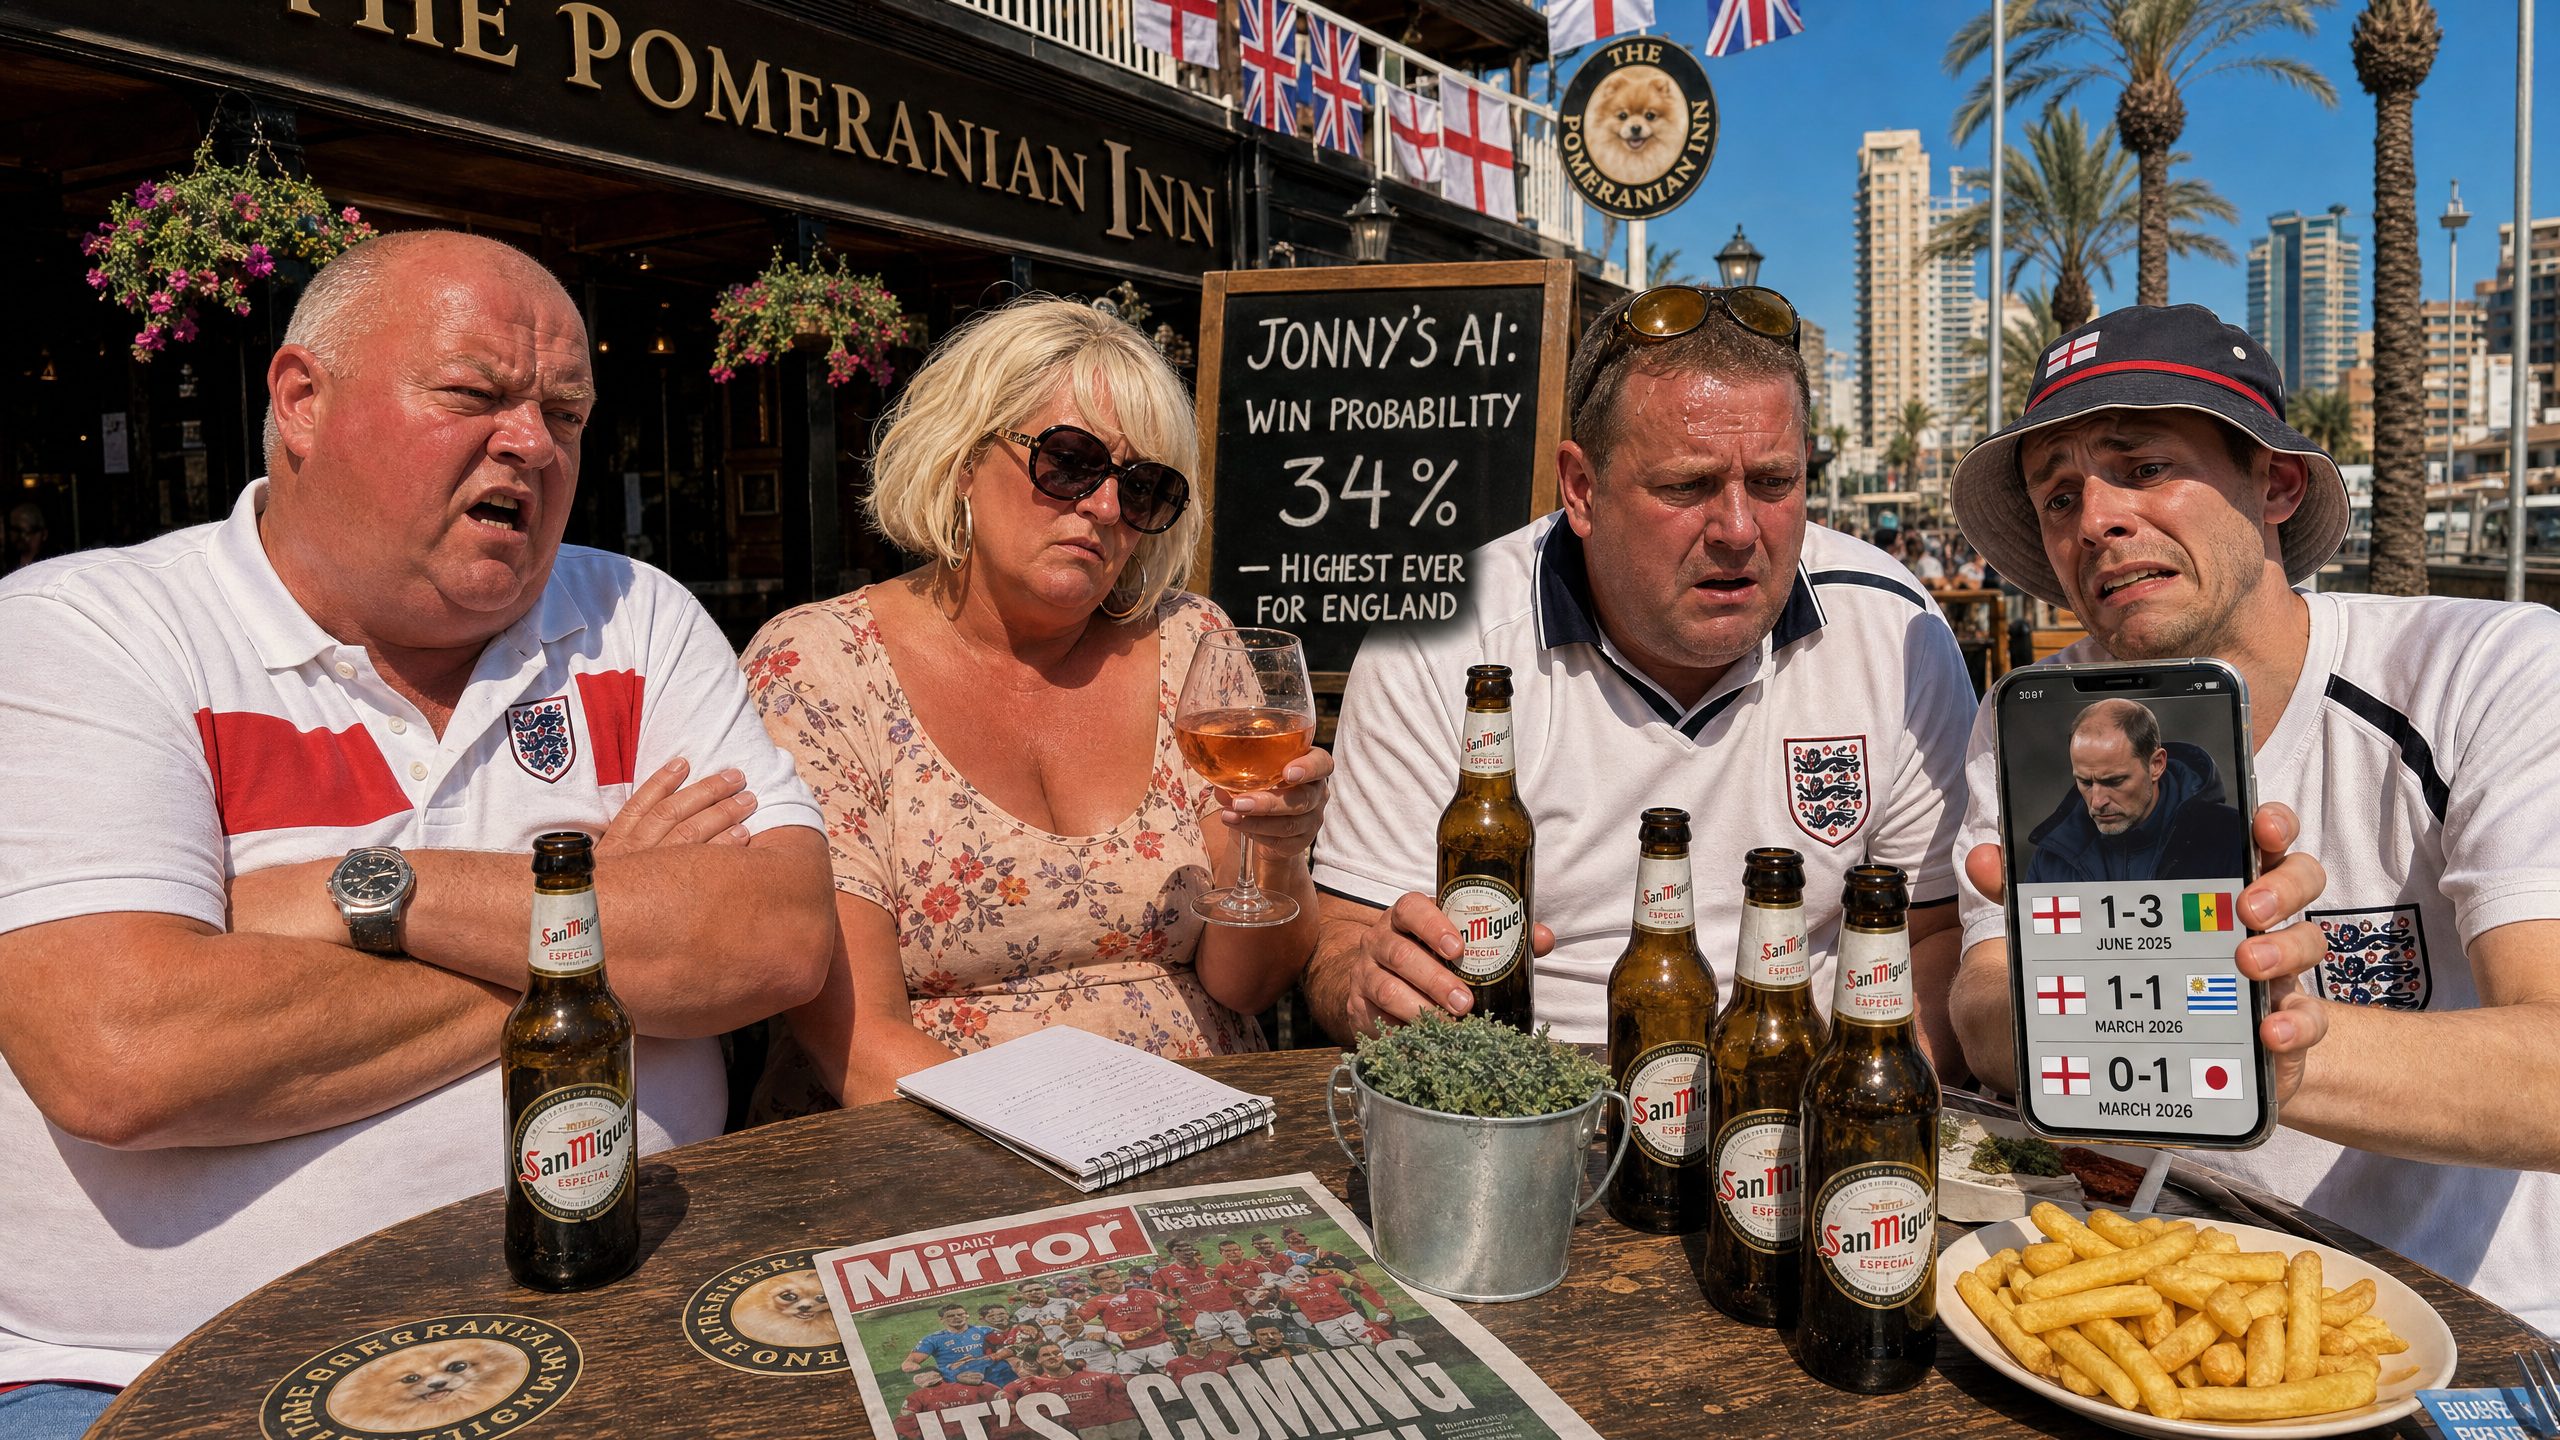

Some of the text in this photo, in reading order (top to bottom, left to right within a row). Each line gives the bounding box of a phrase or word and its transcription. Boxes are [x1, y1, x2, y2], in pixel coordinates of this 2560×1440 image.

[1607, 43, 1663, 67] THE
[556, 2, 1087, 212] POMERANIAN
[1104, 139, 1215, 247] INN
[1563, 99, 1710, 209] POMERANIAN INN
[1246, 304, 1438, 370] JONNY'S
[1246, 393, 1521, 435] WIN PROBABILITY
[1281, 553, 1394, 583] HIGHEST
[1402, 553, 1466, 583] EVER
[1257, 592, 1458, 625] FOR ENGLAND
[2101, 894, 2164, 928] 1-3
[549, 948, 593, 961] ESPECIAL
[2096, 936, 2172, 951] JUNE 2025
[2107, 975, 2162, 1010] 1-1
[2095, 1020, 2183, 1034] MARCH 2026
[2108, 1056, 2169, 1093] 0-1
[2099, 1102, 2193, 1119] MARCH 2026
[558, 1169, 610, 1188] ESPECIAL
[948, 1234, 997, 1253] DAILY
[842, 1219, 1124, 1305] Mirror
[1860, 1256, 1915, 1270] ESPECIAL
[1126, 1338, 1476, 1440] COMING
